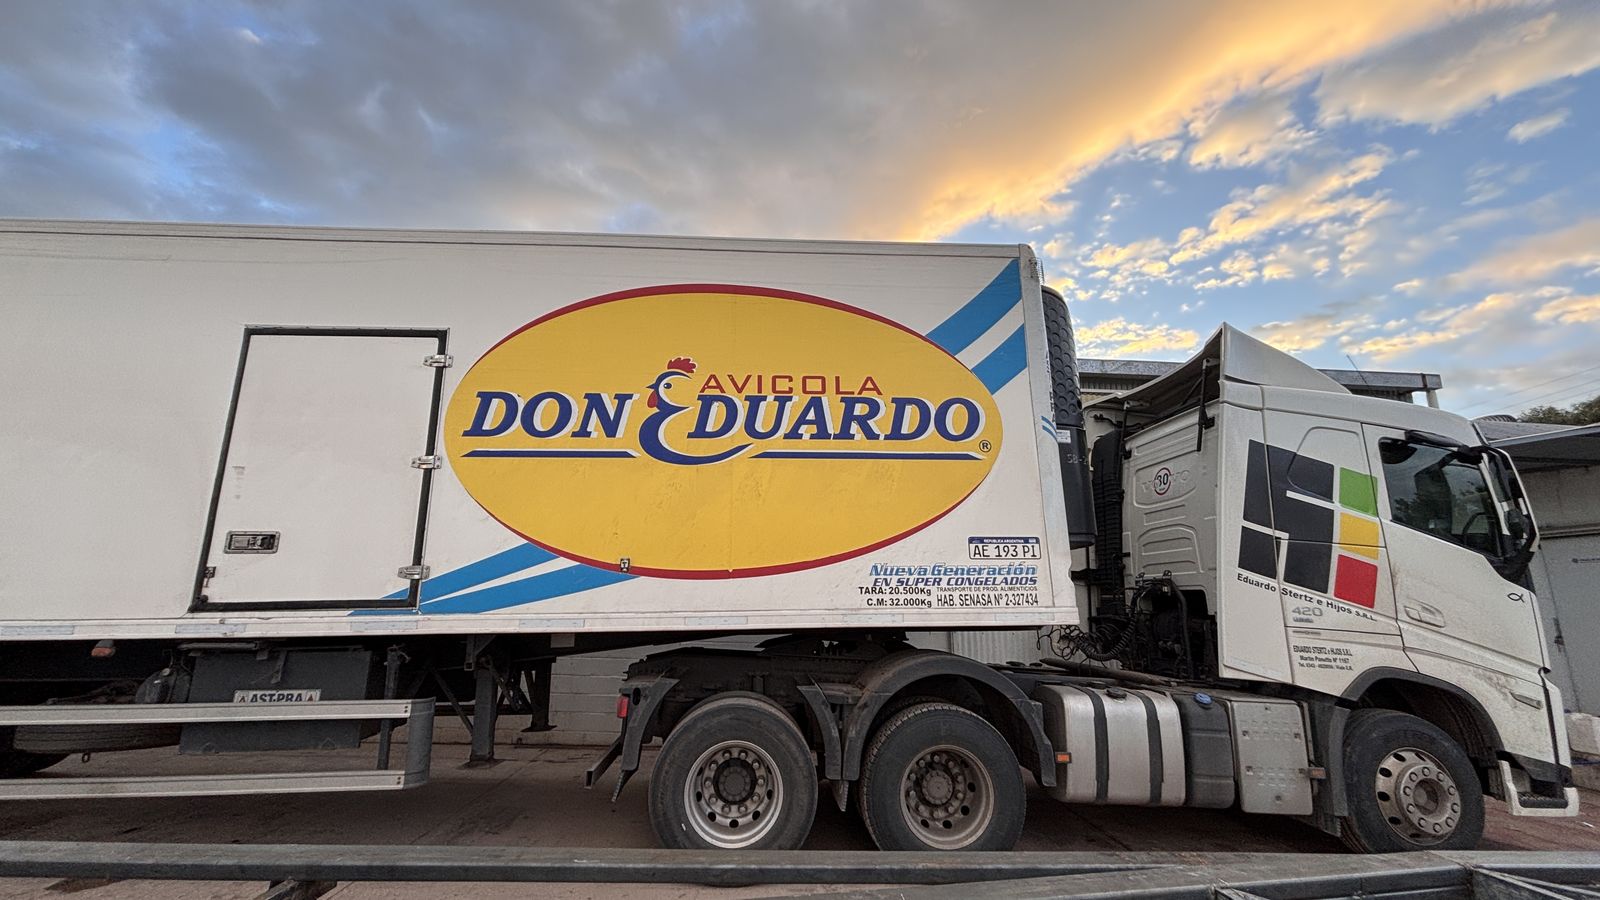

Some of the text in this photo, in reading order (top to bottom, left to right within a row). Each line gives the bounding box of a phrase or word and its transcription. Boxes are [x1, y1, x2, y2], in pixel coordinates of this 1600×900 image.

[699, 374, 882, 396] AVICOLA
[461, 390, 639, 439] DON
[973, 545, 990, 557] AE
[994, 545, 1018, 557] 193
[869, 561, 1037, 577] Nueva Generación
[873, 577, 1038, 587] EN SUPER CONGELADOS
[858, 587, 932, 596] TARA: 20.500Kg
[1237, 573, 1277, 592] Eduardo
[1281, 587, 1314, 603] Stertz
[1326, 601, 1352, 615] Hijos
[866, 598, 932, 608] C.M: 32.000Kg
[936, 594, 958, 607] HAB.
[959, 594, 993, 607] SENASA
[1005, 593, 1039, 607] 2-327434
[1291, 606, 1323, 617] 420
